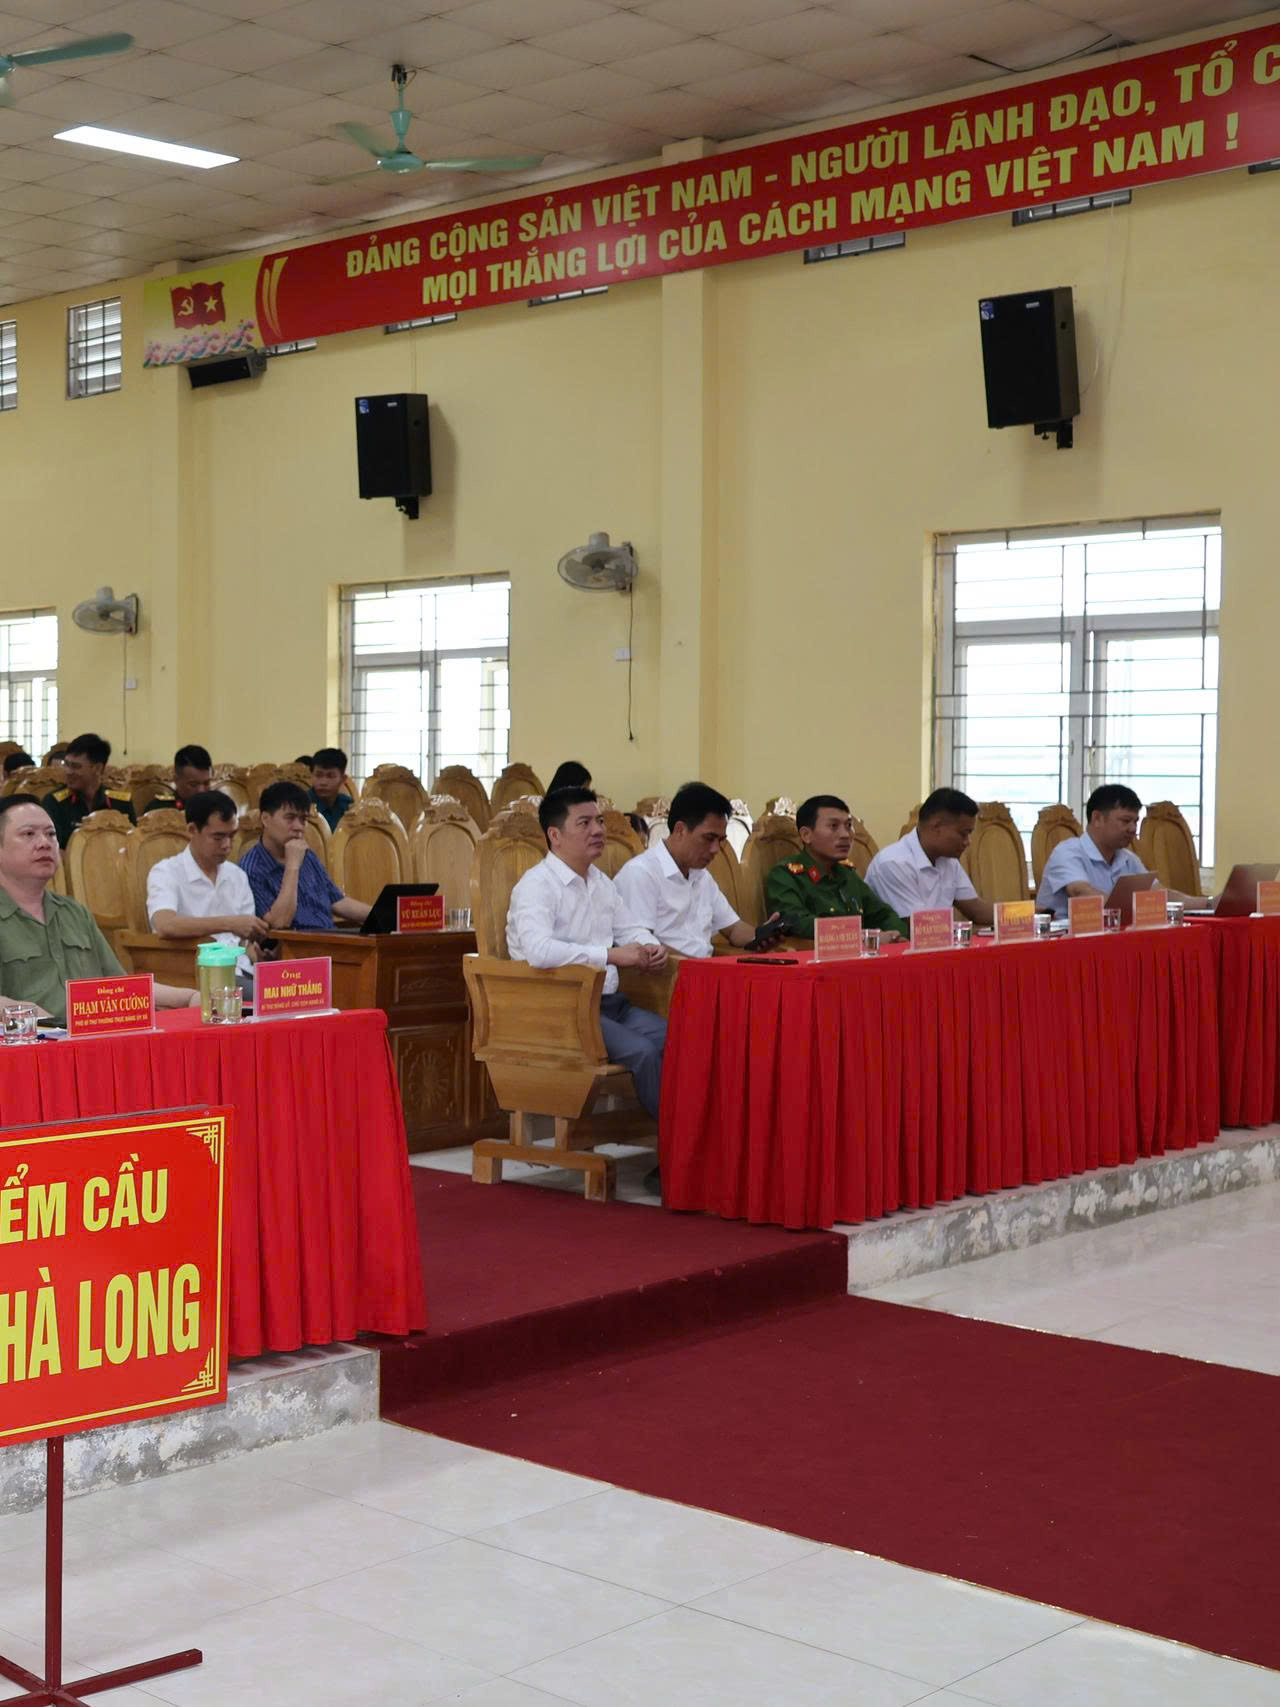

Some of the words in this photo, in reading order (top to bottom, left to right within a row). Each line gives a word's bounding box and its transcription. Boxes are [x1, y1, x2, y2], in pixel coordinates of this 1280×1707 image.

[347, 234, 420, 278] ĐẢNG
[431, 218, 508, 262] CỘNG
[519, 195, 582, 243] SẢN
[592, 186, 661, 227] VIỆT
[672, 165, 752, 210] NAM
[791, 125, 908, 187] NGƯỜI
[924, 103, 1034, 158] LÃNH
[1049, 79, 1156, 131] ĐẠO,
[1174, 40, 1238, 104] TỔ
[422, 269, 476, 306] MỌI
[487, 240, 586, 293] THẮNG
[597, 234, 647, 274] LỢI
[658, 212, 727, 261] CỦA
[739, 196, 837, 247] CÁCH
[850, 170, 971, 225] MẠNG
[986, 145, 1078, 198] VIỆT
[1093, 120, 1204, 177] NAM
[1225, 112, 1240, 150] !
[73, 1000, 99, 1017] PHẠM
[263, 987, 279, 999] MAI
[82, 1153, 168, 1233] CẦU
[77, 1262, 201, 1371] LONG
